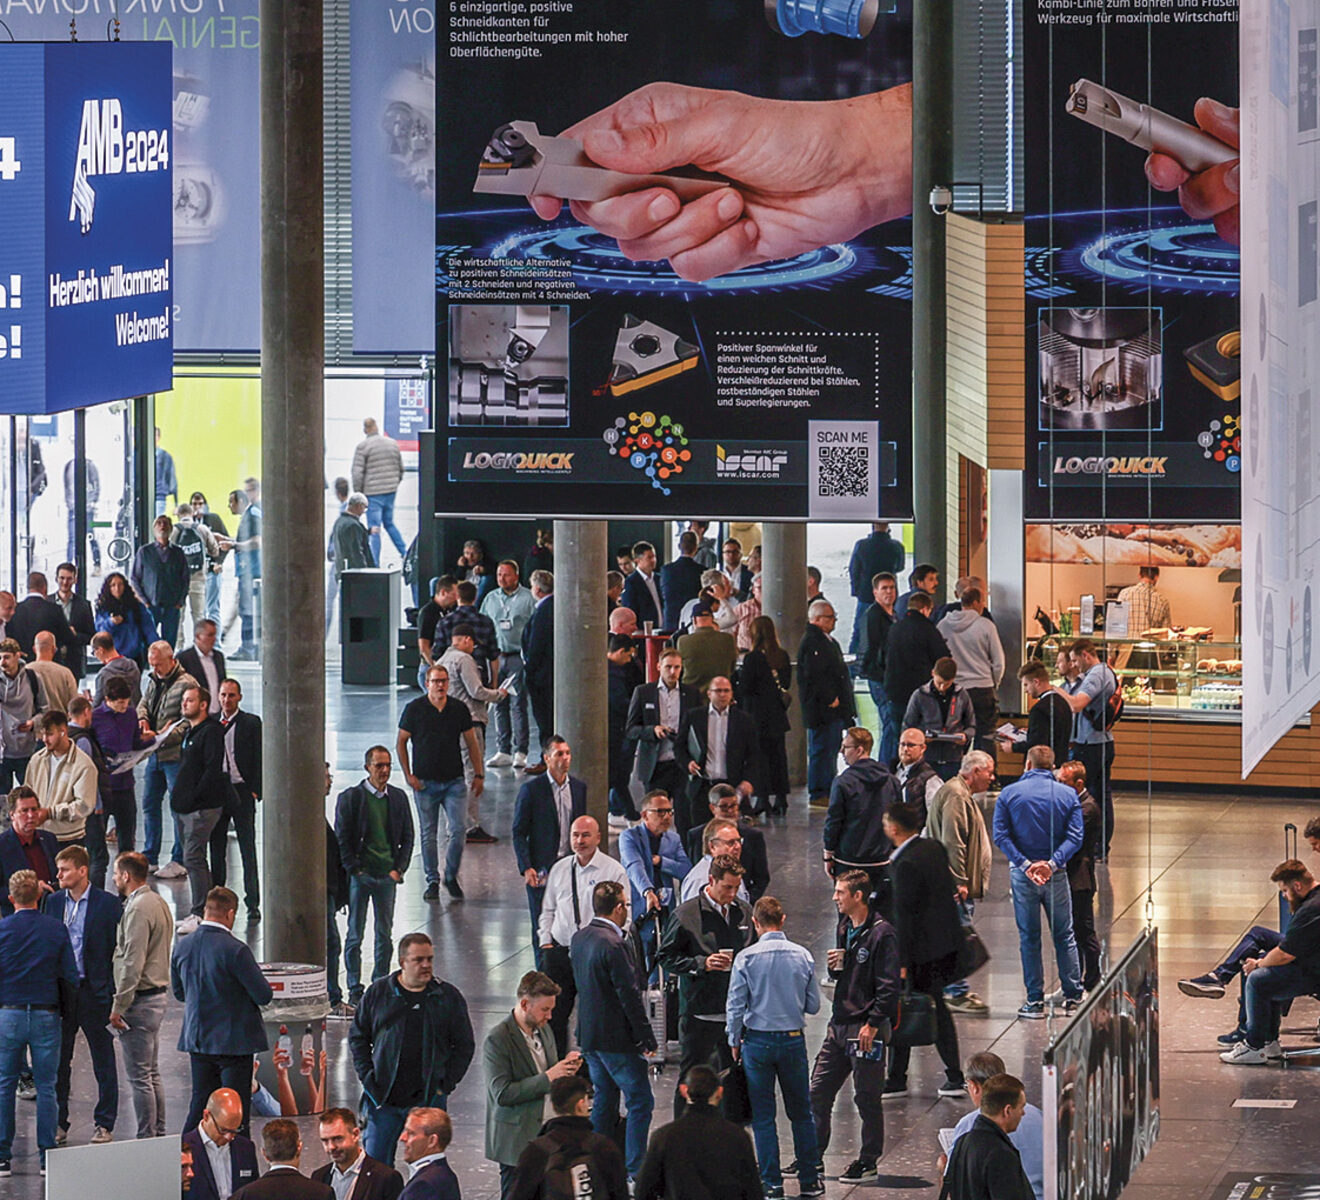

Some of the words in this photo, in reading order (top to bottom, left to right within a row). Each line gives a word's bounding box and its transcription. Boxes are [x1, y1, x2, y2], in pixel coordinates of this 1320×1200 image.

[449, 2, 457, 12] 6
[460, 1, 527, 14] einzigartige,
[530, 1, 573, 14] positive
[1134, 0, 1173, 8] Bohren
[449, 16, 530, 27] Schneidkanten
[533, 16, 550, 27] für
[1038, 12, 1093, 25] Werkzeug
[1096, 12, 1113, 23] für
[1116, 12, 1171, 23] maximale
[449, 31, 572, 44] Schlichtbearbeitungen
[575, 31, 594, 42] mit
[597, 31, 629, 42] hoher
[449, 46, 543, 59] Oberflächengüte.
[68, 97, 124, 223] AMB
[126, 129, 169, 174] 2024
[449, 259, 461, 267] Die
[464, 258, 524, 267] wirtschaftliche
[526, 259, 572, 267] Alternative
[460, 269, 498, 279] positiven
[500, 269, 572, 278] Schneideinsätzen
[49, 268, 99, 309] Herzlich
[100, 258, 169, 302] willkommen!
[449, 280, 463, 288] mit
[464, 280, 471, 288] 2
[472, 280, 515, 288] Schneiden
[516, 280, 533, 288] und
[534, 280, 576, 290] negativen
[449, 291, 521, 299] Schneideinsätzen
[522, 291, 537, 299] mit
[538, 291, 545, 299] 4
[546, 291, 592, 300] Schneiden.
[116, 313, 169, 347] Welcome!
[717, 343, 754, 352] Positiver
[756, 343, 804, 354] Spanwinkel
[806, 343, 818, 352] für
[717, 354, 741, 363] einen
[742, 354, 777, 363] weichen
[778, 354, 809, 363] Schnitt
[810, 355, 827, 363] und
[717, 365, 769, 376] Reduzierung
[771, 365, 786, 374] der
[717, 376, 809, 386] Verschleißreduzierend
[811, 376, 825, 385] bei
[717, 387, 786, 398] rostbeständigen
[787, 388, 820, 396] Stählen
[717, 398, 734, 407] und
[735, 398, 812, 409] Superlegierungen.
[817, 432, 849, 443] SCAN
[851, 432, 868, 443] ME
[462, 452, 575, 469] LOGIQUICK
[1053, 457, 1168, 474] LOGIQUICK
